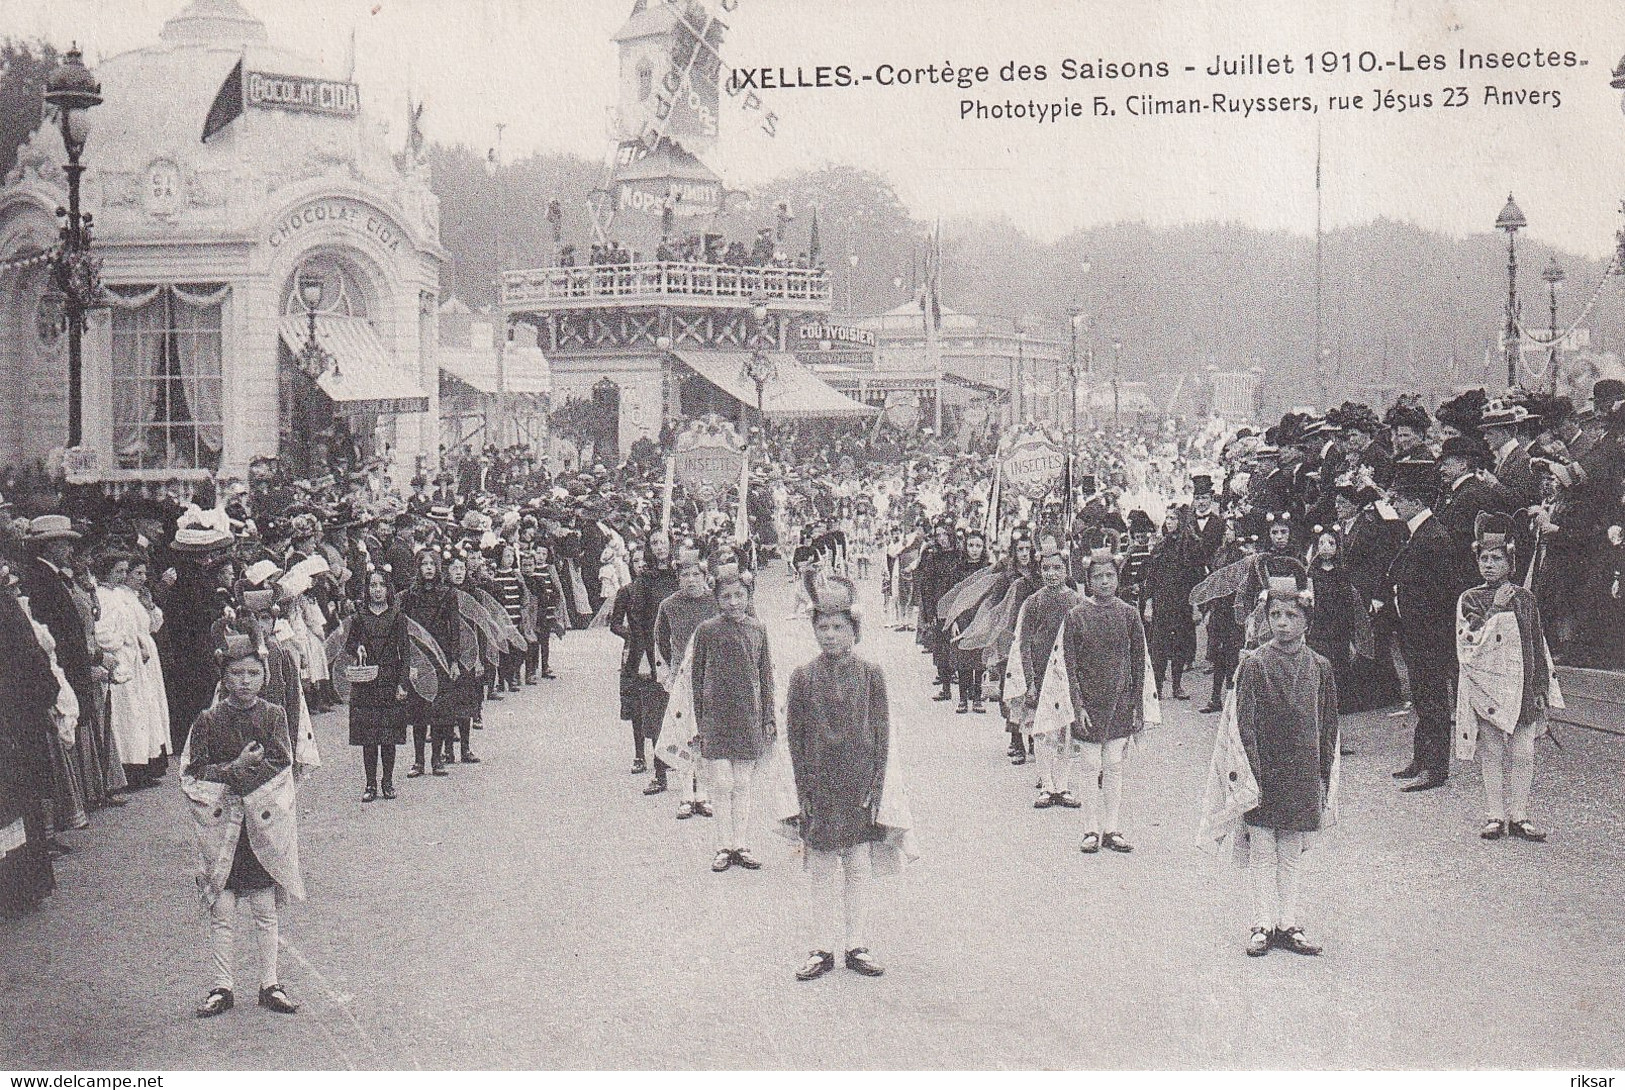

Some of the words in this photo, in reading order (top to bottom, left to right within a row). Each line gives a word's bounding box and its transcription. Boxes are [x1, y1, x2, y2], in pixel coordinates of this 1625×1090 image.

[248, 74, 317, 104] CHOCOLAT
[320, 81, 360, 114] CIDA
[268, 205, 358, 248] CHOCOLAT
[366, 216, 399, 251] CIDA
[1010, 455, 1062, 476] INSECTES
